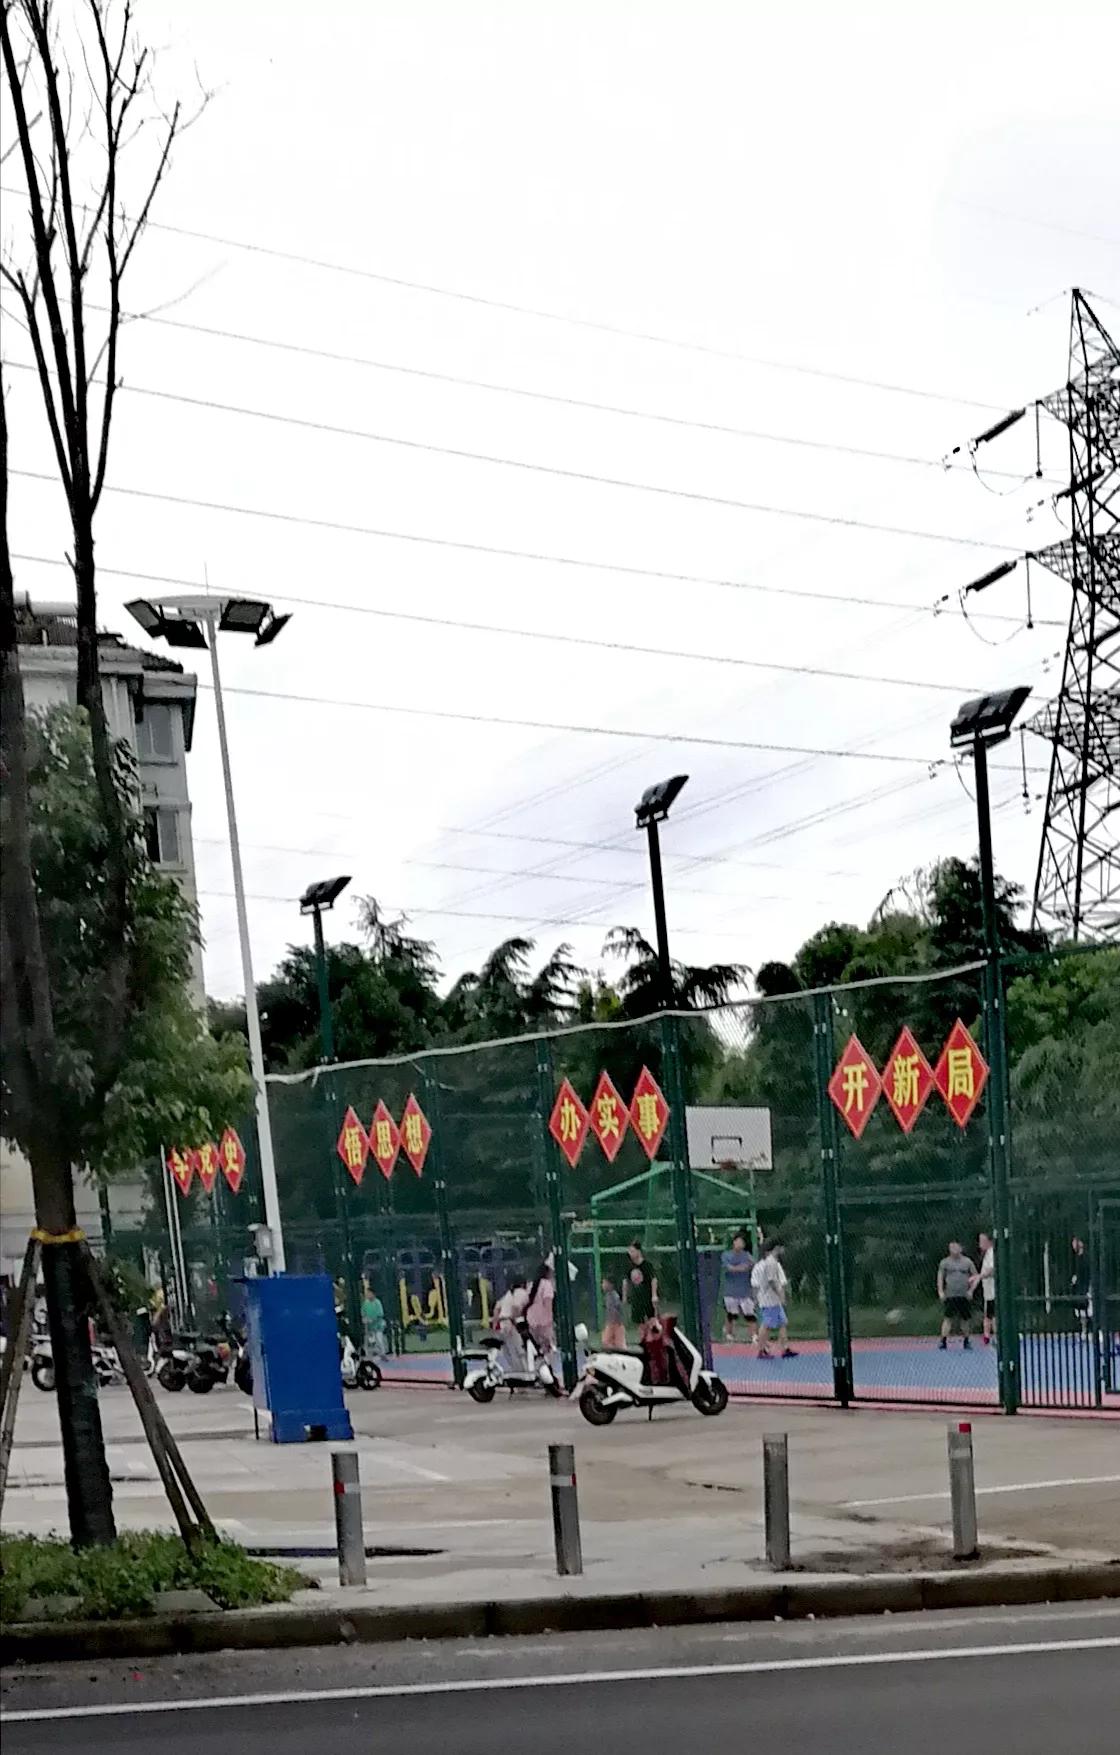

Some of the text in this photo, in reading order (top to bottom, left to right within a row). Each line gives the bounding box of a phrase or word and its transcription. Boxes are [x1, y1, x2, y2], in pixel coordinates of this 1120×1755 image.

[841, 1047, 974, 1114] 开新局
[344, 1114, 423, 1168] 悟思想
[560, 1093, 660, 1142] 办实事
